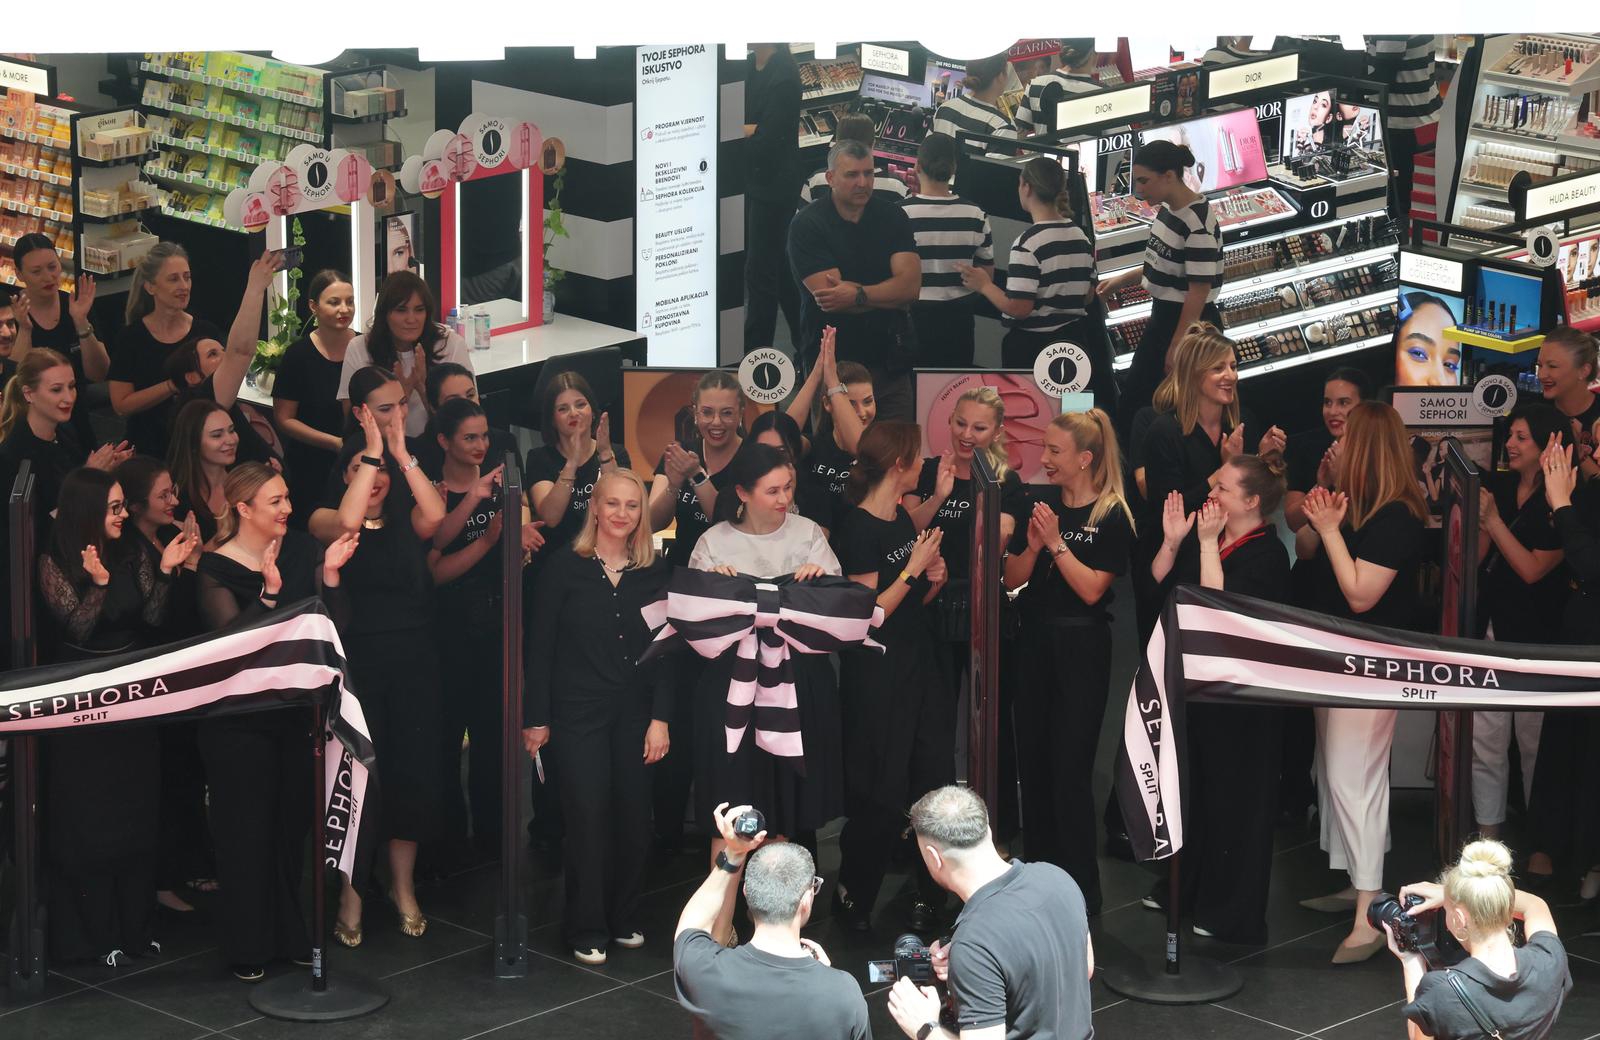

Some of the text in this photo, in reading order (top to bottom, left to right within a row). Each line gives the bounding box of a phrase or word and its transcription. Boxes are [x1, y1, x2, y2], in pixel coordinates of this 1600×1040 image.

[641, 43, 706, 63] TVOJE SEPHORA
[872, 49, 899, 60] SEPHORA
[642, 60, 683, 76] ISKUSTVO
[867, 58, 904, 72] COLLECTION
[2, 70, 29, 83] & MORE
[1245, 71, 1262, 83] DIOR
[1095, 102, 1113, 115] DIOR
[479, 120, 498, 135] SAMO
[655, 120, 680, 130] PROGRAM
[1098, 132, 1133, 153] DIOR
[303, 151, 324, 166] SAMO
[478, 150, 506, 165] SEPHORI
[655, 161, 669, 170] NOVI
[655, 165, 688, 178] EKSKLUZIVNI
[655, 174, 681, 185] BRENDOVI
[303, 182, 332, 198] SEPHORI
[655, 191, 678, 201] SEPHORA
[679, 185, 705, 195] KOLEKCIJA
[1549, 185, 1597, 206] HUDA BEAUTY
[655, 230, 673, 240] BEAUTY
[655, 247, 699, 261] PERSONALIZIRANI
[655, 259, 678, 269] POKLONI
[1415, 258, 1449, 272] SEPHORA
[1408, 267, 1455, 285] COLLECTION
[655, 290, 709, 308] MOBILNA APLIKACIJA
[654, 309, 690, 323] JEDNOSTAVNA
[654, 319, 681, 330] KUPOVINA
[748, 352, 786, 366] SAMO U
[1046, 346, 1084, 362] SAMO U
[746, 385, 788, 401] SEPHORI
[1040, 378, 1081, 395] SEPHORI
[1480, 378, 1498, 389] NOVO
[1503, 381, 1514, 398] SAMO
[1420, 397, 1468, 408] SAMO U
[1420, 409, 1467, 420] SEPHORI
[938, 510, 962, 518] SPLIT
[886, 540, 915, 563] SEPHO
[1344, 655, 1500, 688] SEPHORA
[8, 677, 169, 721] SEPHORA
[1401, 687, 1438, 700] SPLIT
[73, 711, 109, 723] SPLIT
[1139, 762, 1158, 795] SPLIT
[325, 751, 352, 869] SEPHOR
